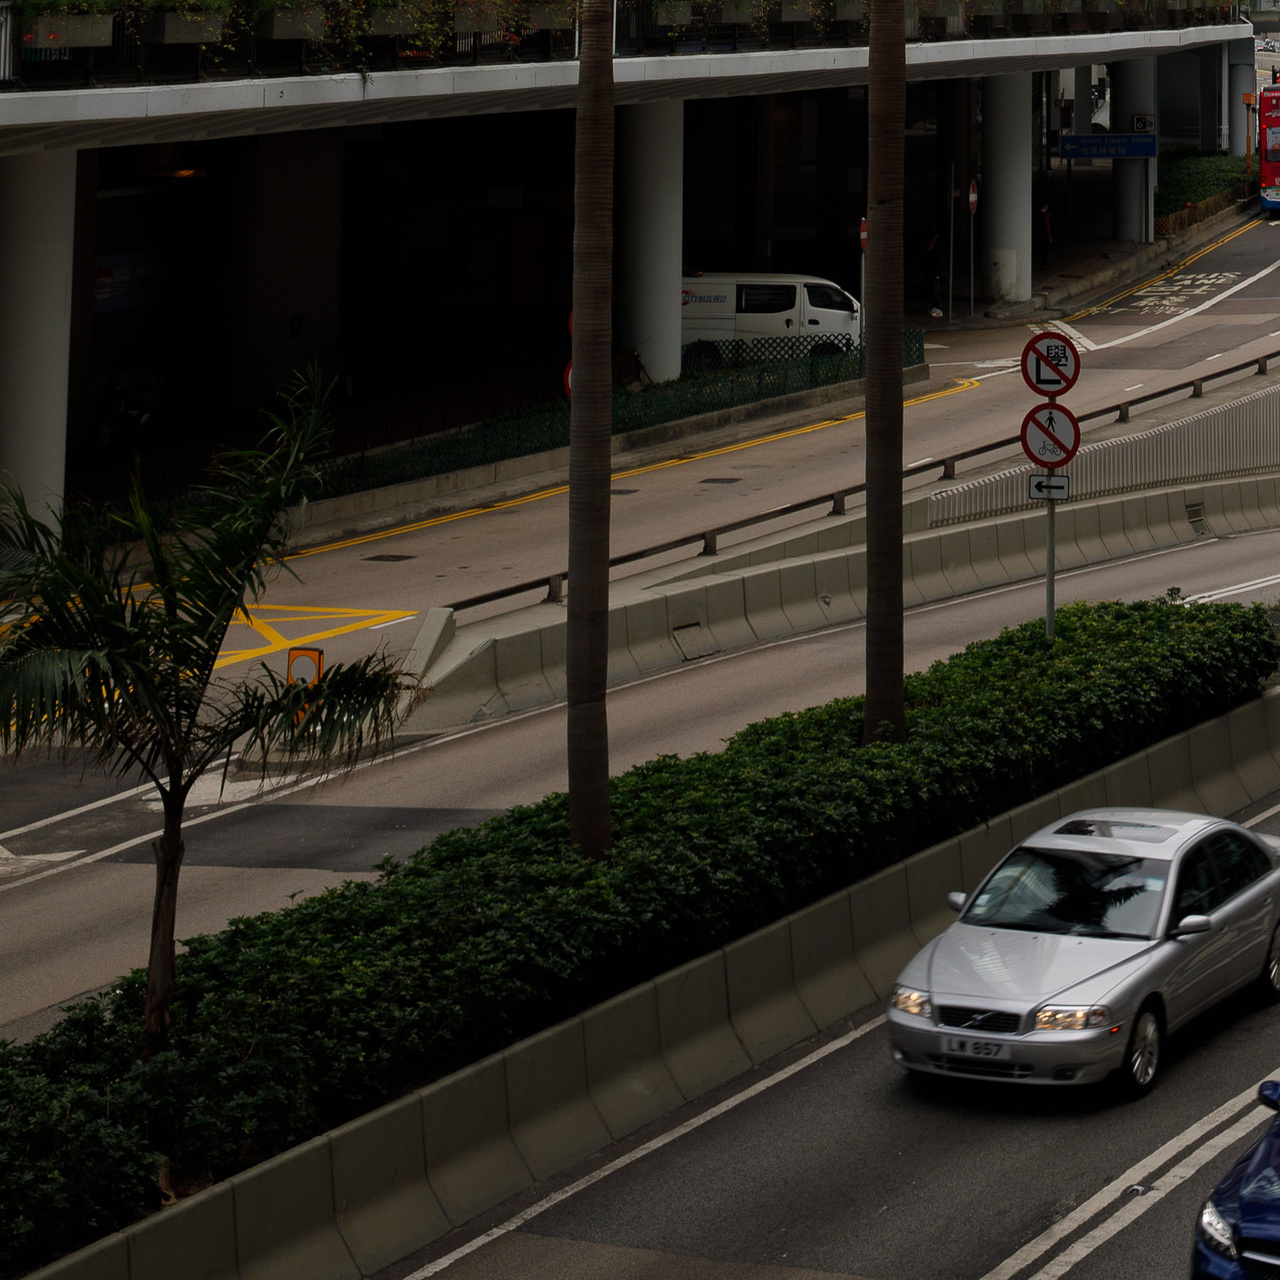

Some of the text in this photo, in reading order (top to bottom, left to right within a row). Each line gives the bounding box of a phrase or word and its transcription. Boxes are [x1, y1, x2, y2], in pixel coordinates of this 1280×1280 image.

[1133, 285, 1217, 296] 巴士
[683, 295, 713, 303] CITYBUS
[972, 1041, 1003, 1057] 857
